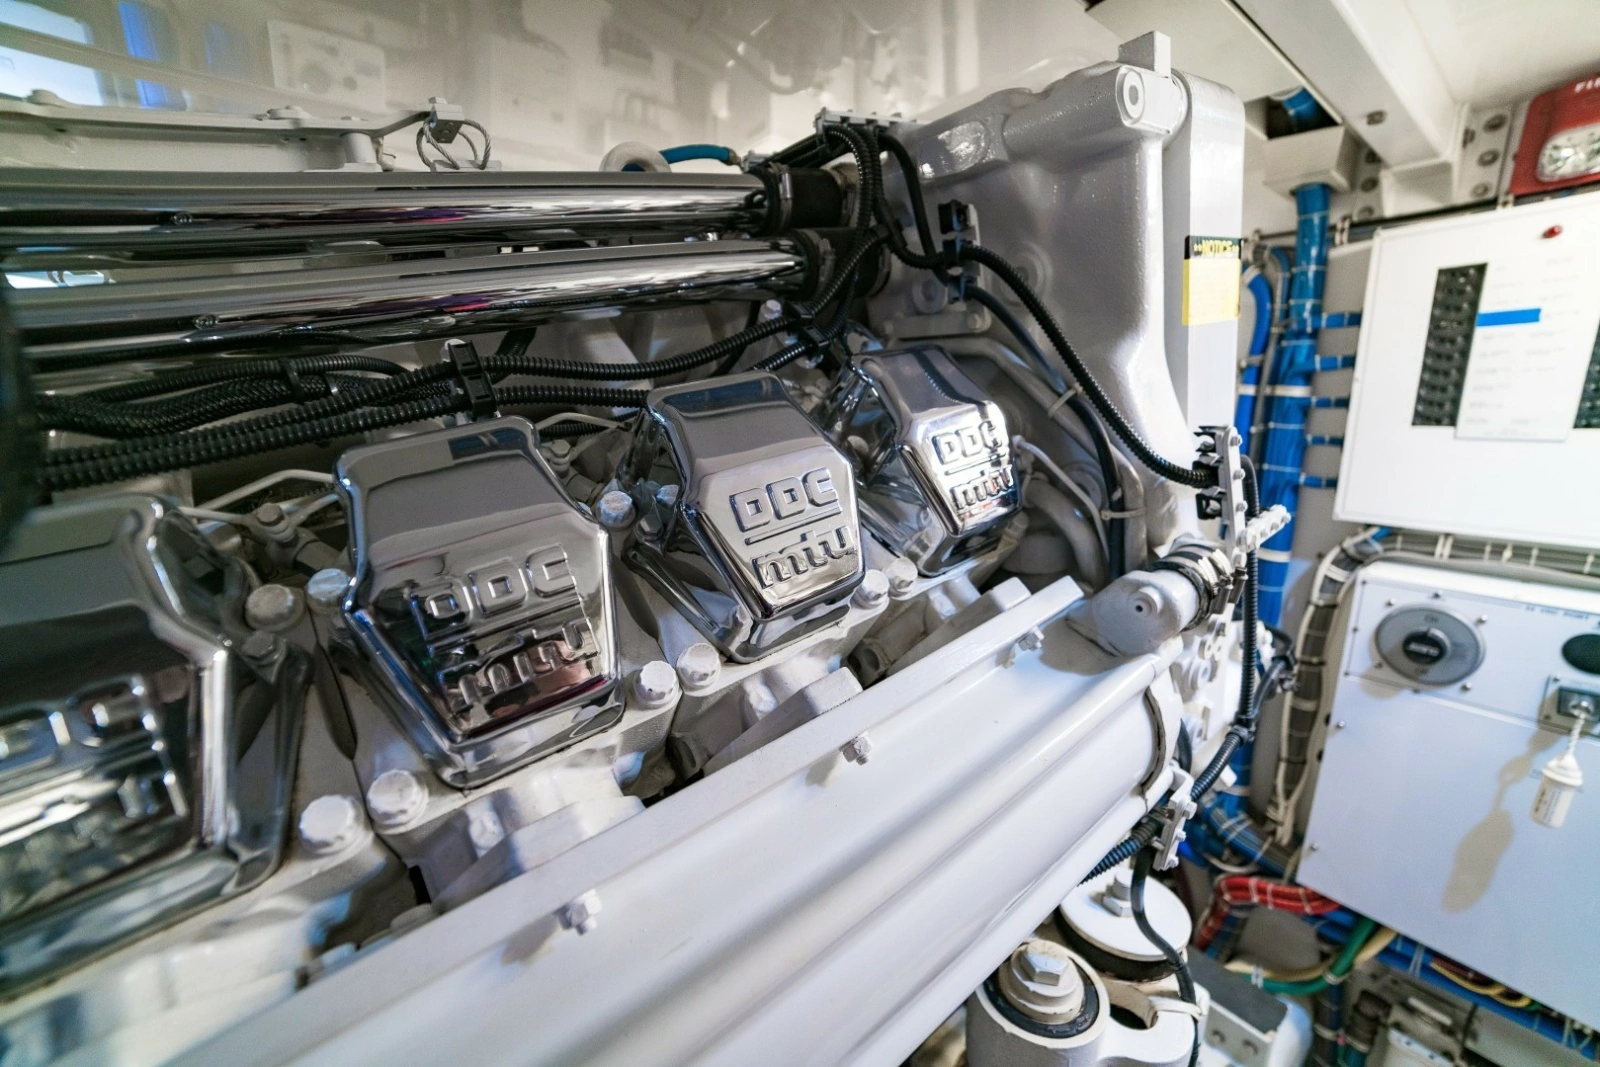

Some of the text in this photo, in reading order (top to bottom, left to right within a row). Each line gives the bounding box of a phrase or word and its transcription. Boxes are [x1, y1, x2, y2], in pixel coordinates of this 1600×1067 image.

[931, 420, 1003, 466] DDC
[730, 467, 840, 533] DDC
[751, 524, 857, 589] mtu
[409, 542, 578, 641] DDC
